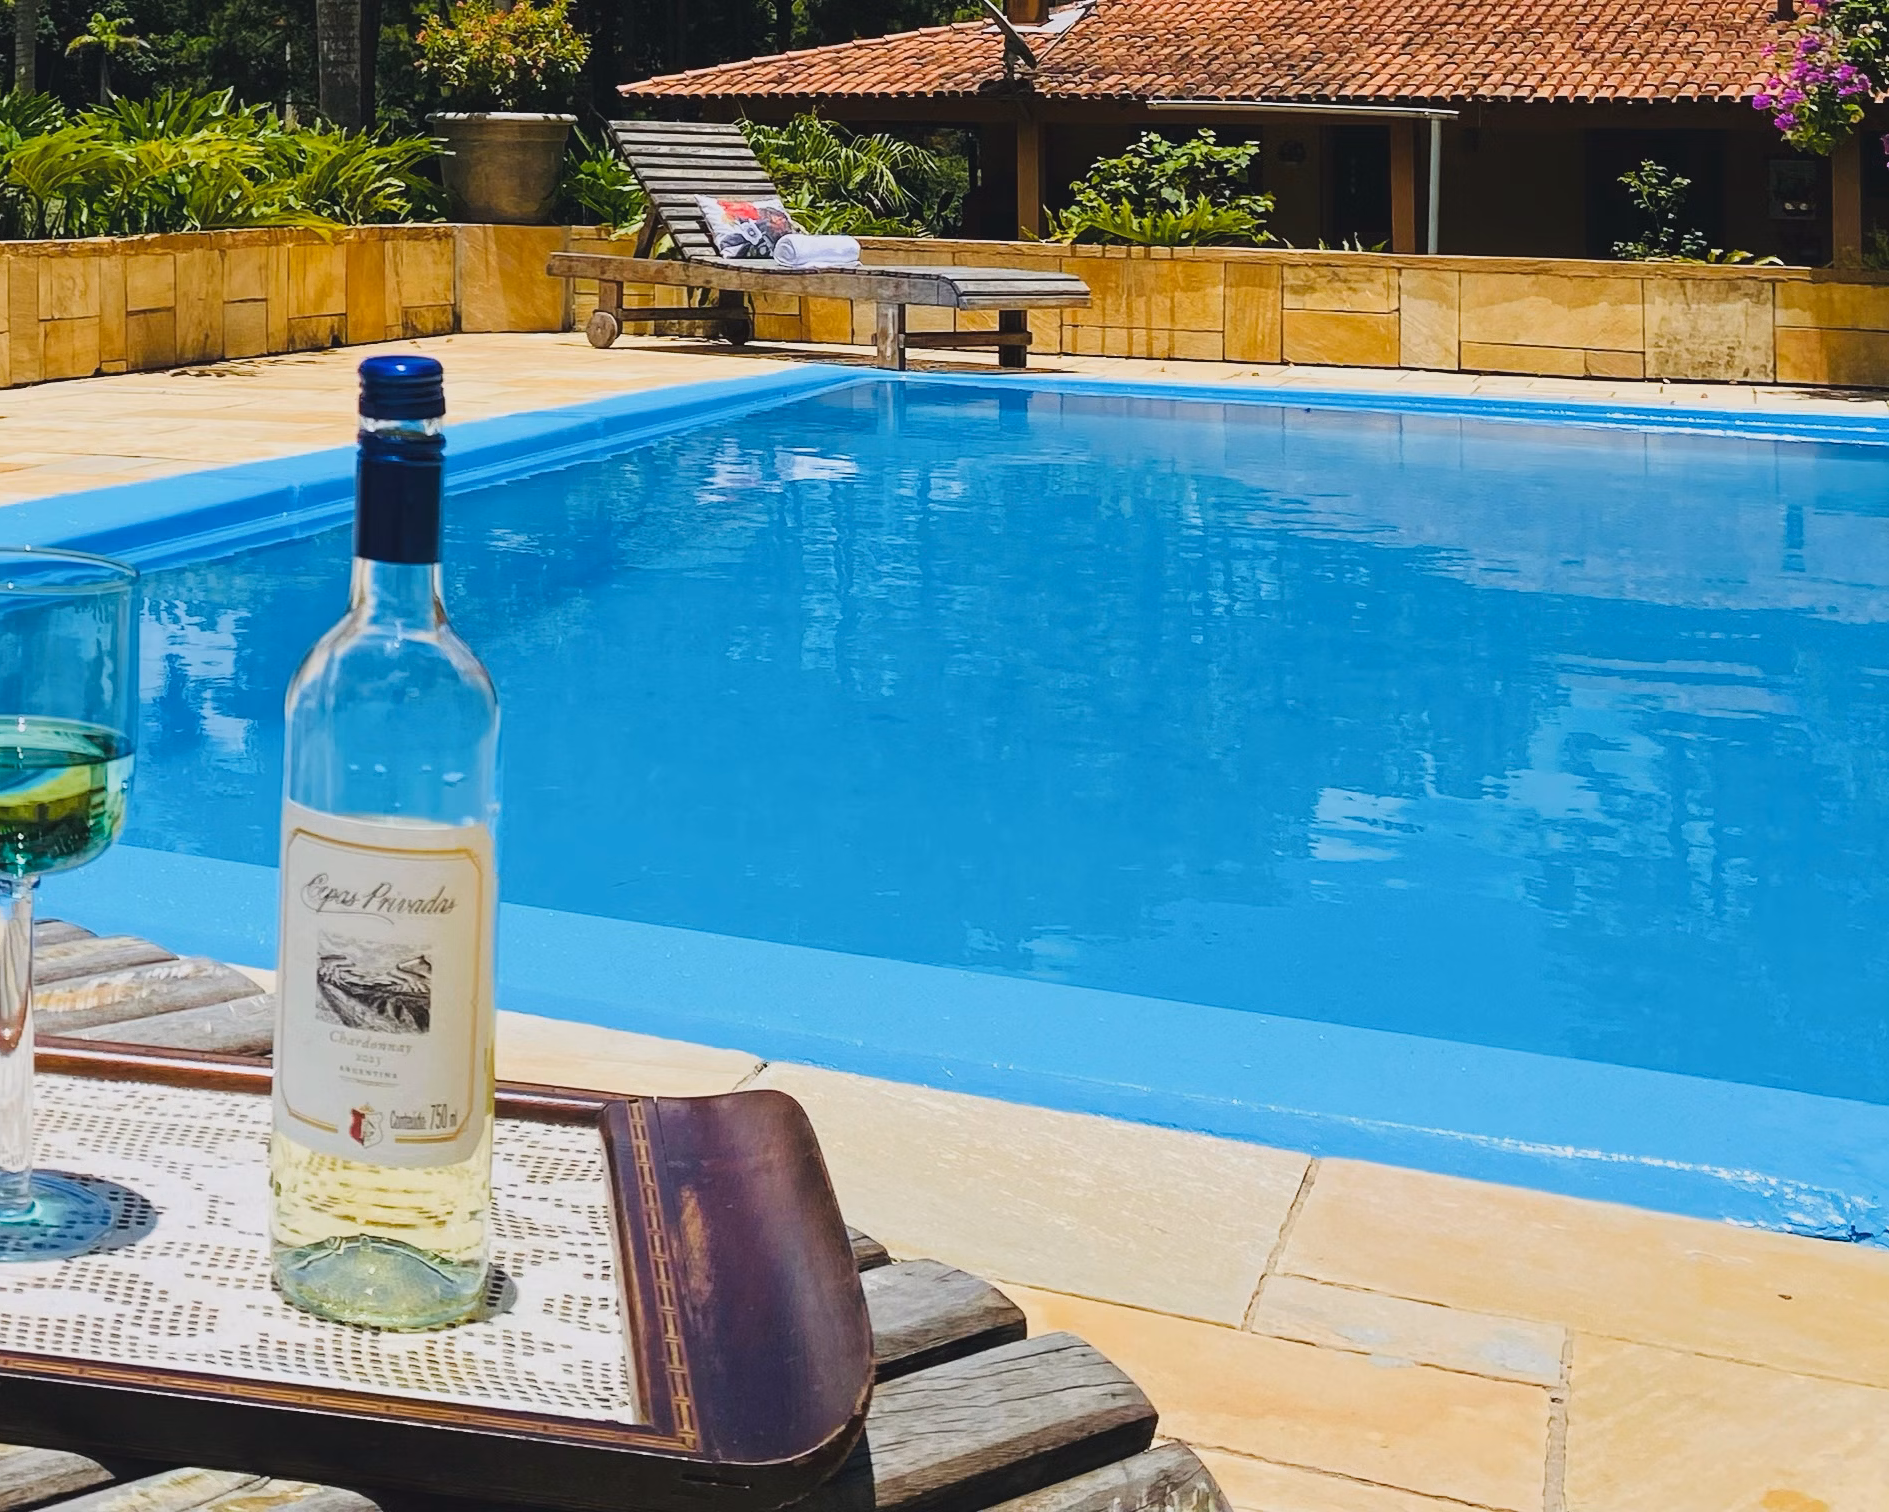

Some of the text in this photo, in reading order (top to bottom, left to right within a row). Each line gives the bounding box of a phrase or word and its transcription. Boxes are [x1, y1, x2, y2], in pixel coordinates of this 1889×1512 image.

[301, 873, 458, 915] Cepas Privadas
[329, 1030, 413, 1056] Chardonnay
[339, 1065, 398, 1079] ARGENTINA
[430, 1103, 448, 1130] 750
